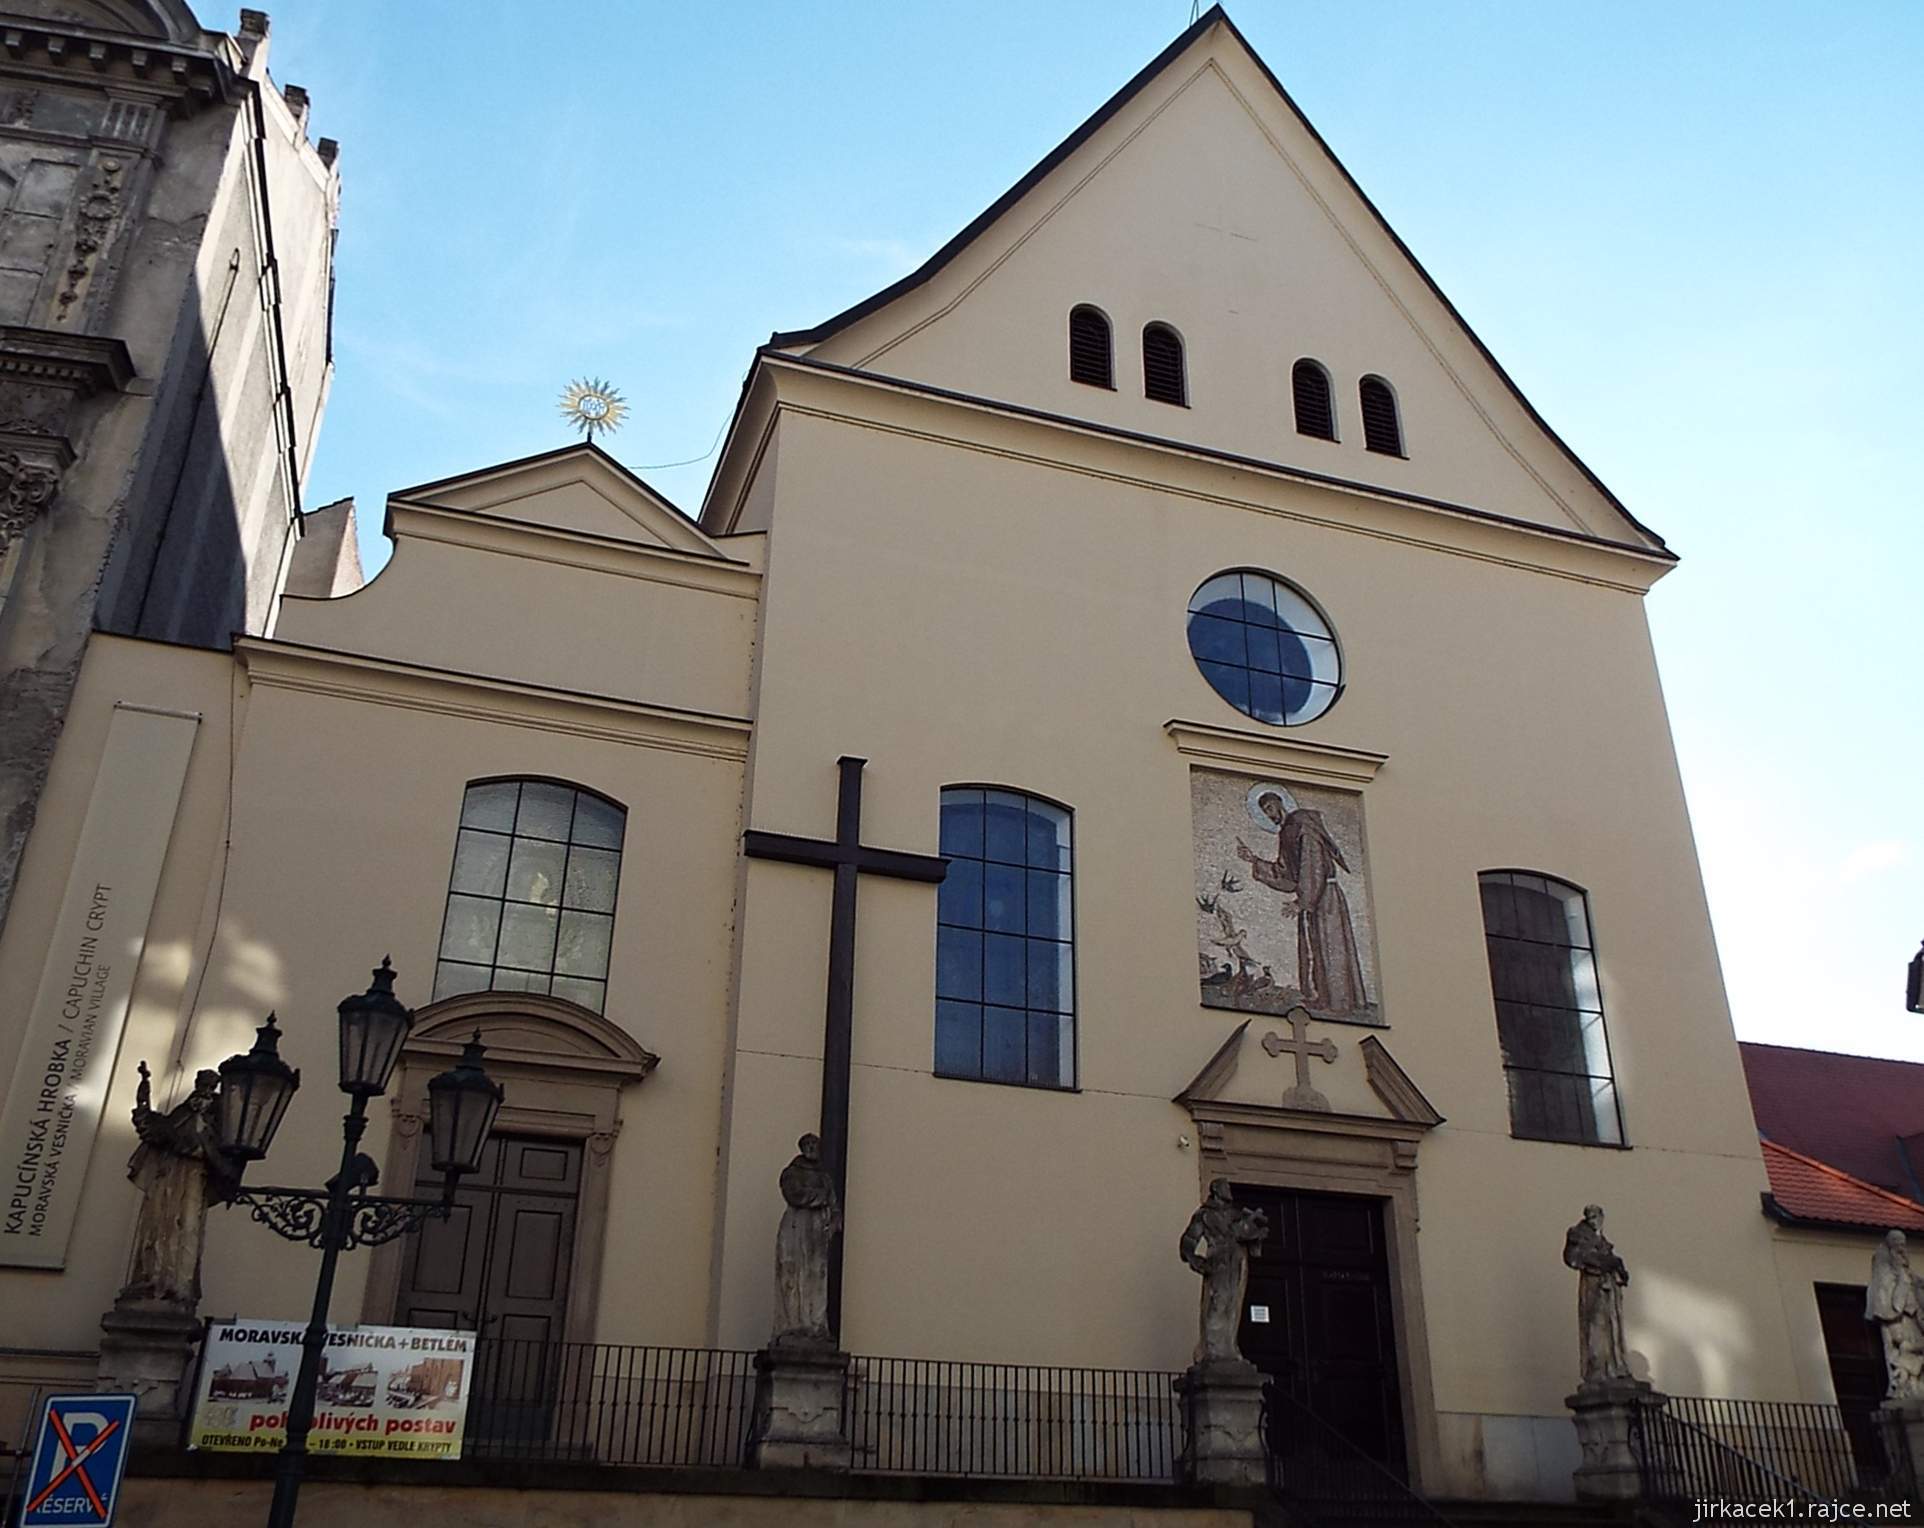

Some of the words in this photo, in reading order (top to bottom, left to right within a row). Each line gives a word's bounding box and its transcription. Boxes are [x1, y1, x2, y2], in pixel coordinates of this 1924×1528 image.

[4, 1118, 50, 1234] KAPUCÍNSKÁ
[37, 1039, 72, 1112] HROBKA
[62, 936, 99, 1020] CAPUCHIN
[86, 883, 112, 931] CRYPT
[29, 1160, 60, 1237] MORAVSKÁ
[50, 1094, 77, 1157] VESNIČKA
[70, 1014, 98, 1081] MORAVIAN
[87, 964, 111, 1011] VILLAGE
[219, 1328, 306, 1347] MORAVSK
[249, 1411, 378, 1435] pohlivých
[384, 1417, 456, 1436] postav
[48, 1411, 110, 1483] P
[201, 1433, 252, 1446] OTEVŘENO
[356, 1439, 386, 1450] VSTUP
[387, 1440, 415, 1451] VEDLE
[416, 1441, 452, 1452] KRYPTY
[35, 1493, 109, 1514] ÉSERV
